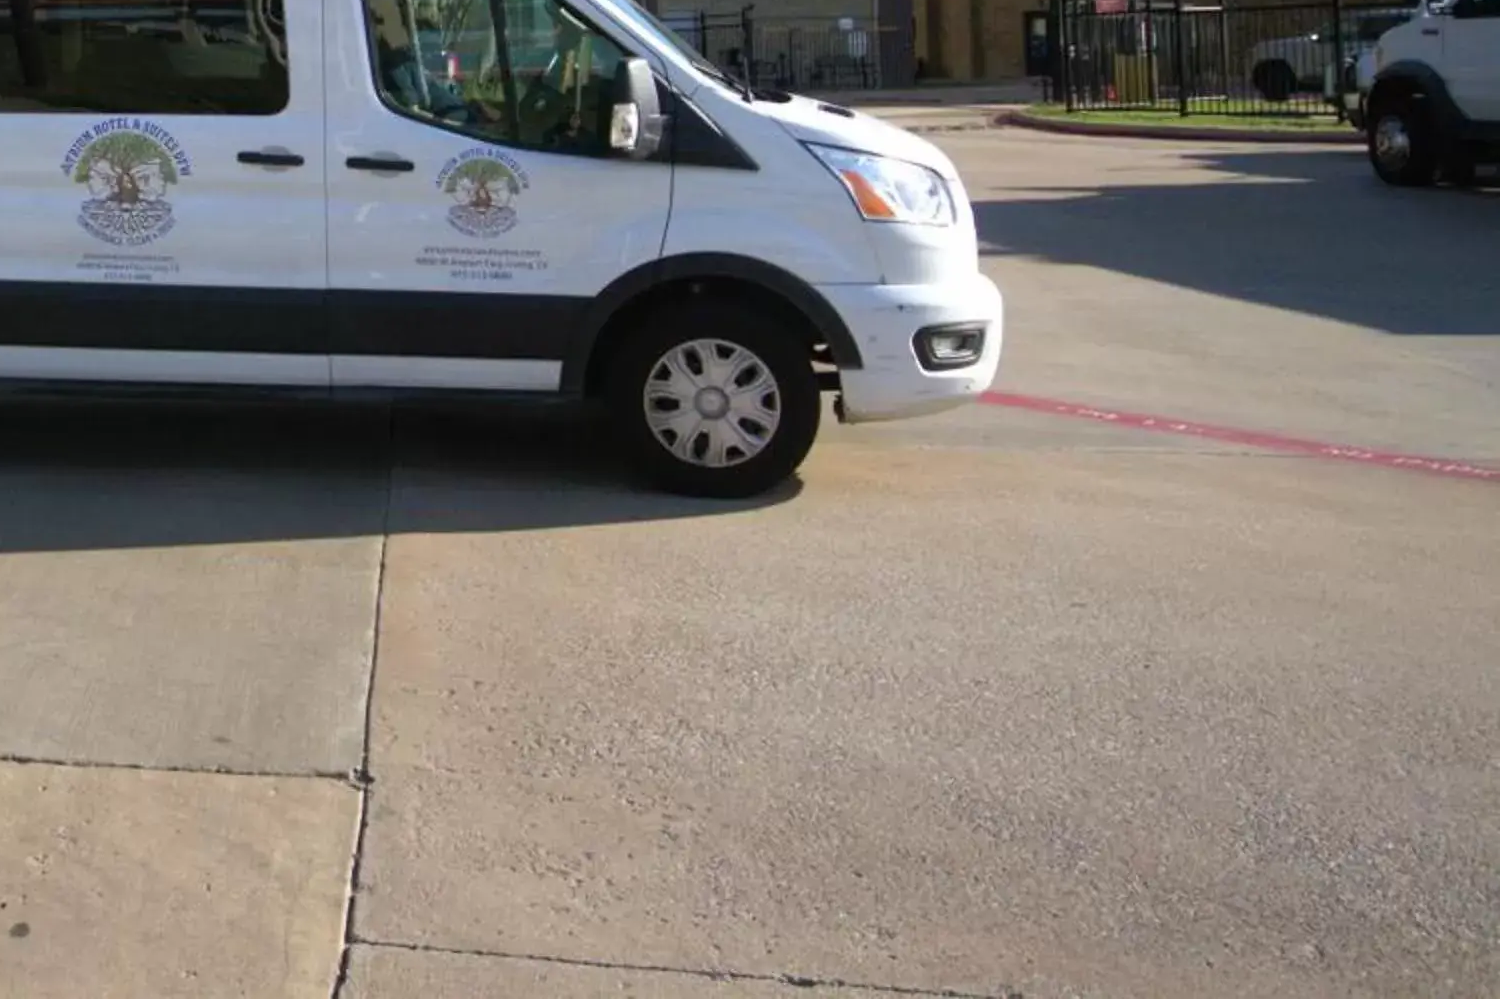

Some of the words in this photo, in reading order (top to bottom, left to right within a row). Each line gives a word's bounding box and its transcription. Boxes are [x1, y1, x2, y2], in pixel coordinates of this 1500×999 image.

[60, 130, 95, 177] ATRIUM
[93, 117, 131, 137] HOTEL
[142, 120, 181, 153] SUITES
